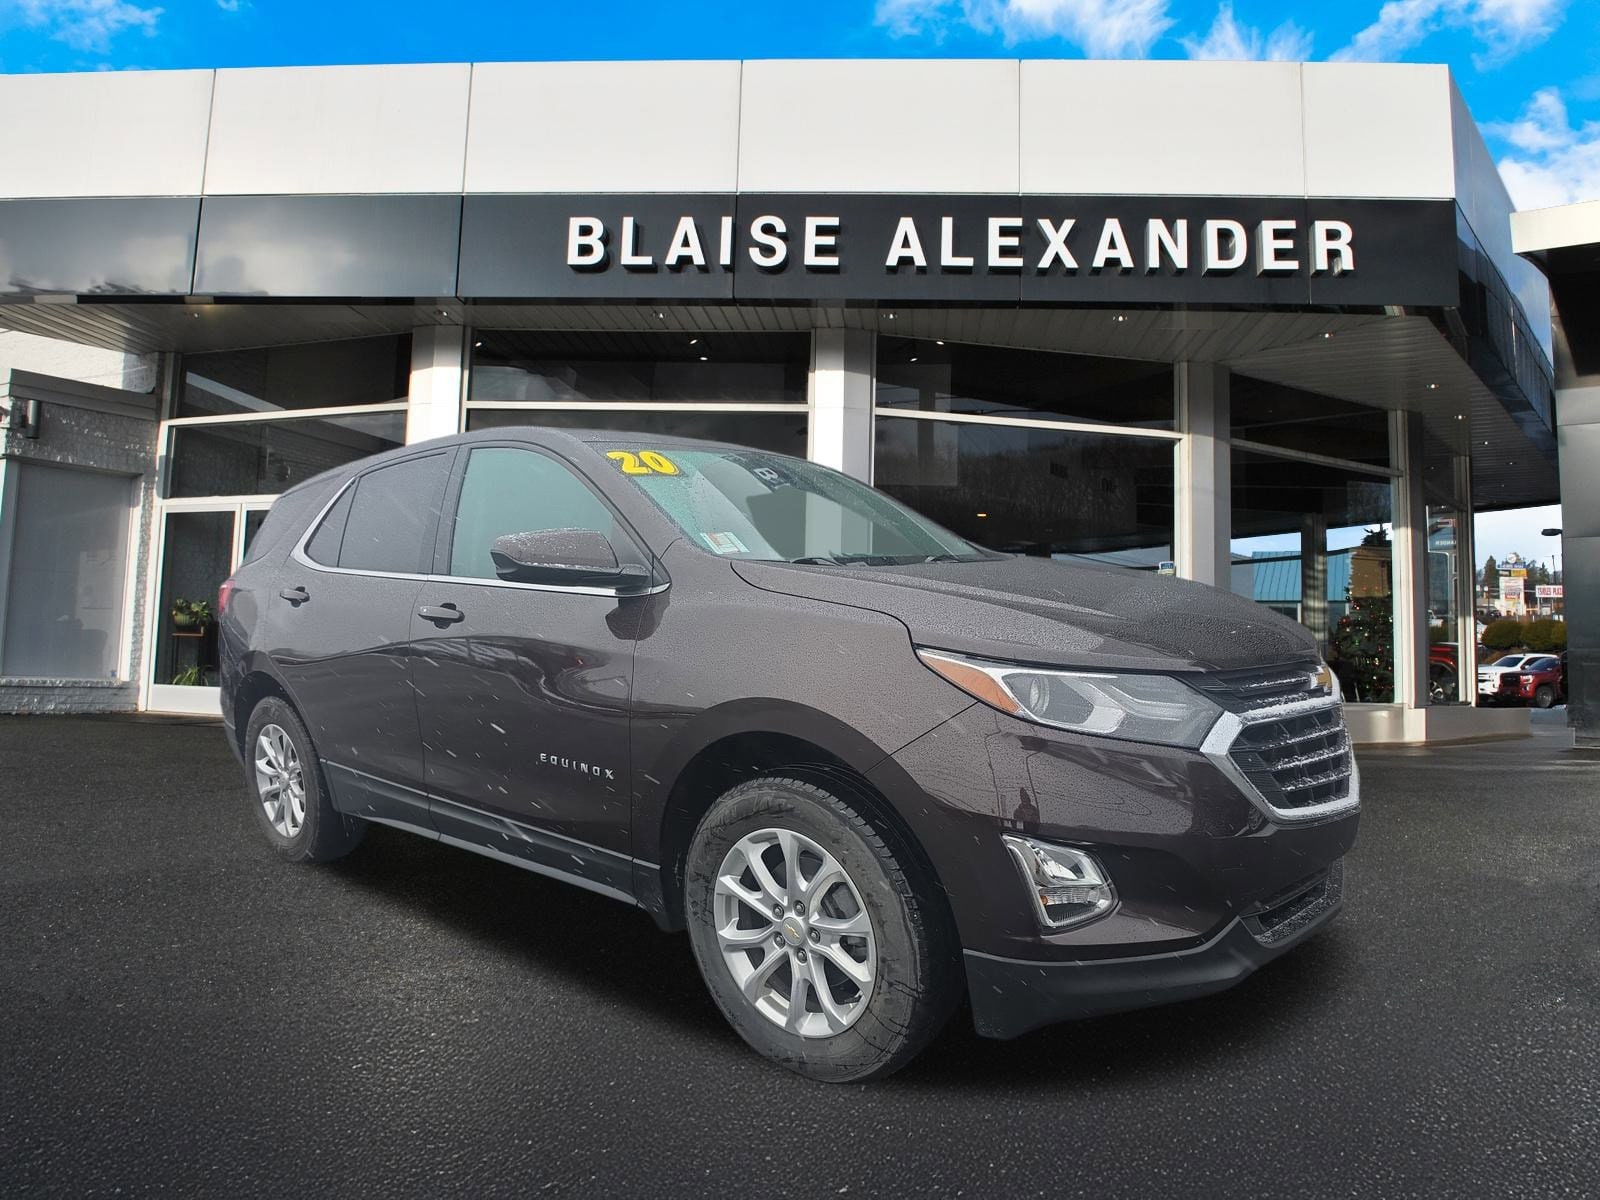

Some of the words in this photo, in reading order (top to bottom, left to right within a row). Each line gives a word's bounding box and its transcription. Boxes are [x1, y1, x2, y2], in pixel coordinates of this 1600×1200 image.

[567, 215, 841, 268] BLAISE
[885, 216, 1355, 272] ALEXANDER
[605, 451, 680, 475] 20
[540, 752, 614, 780] EQUINOX
